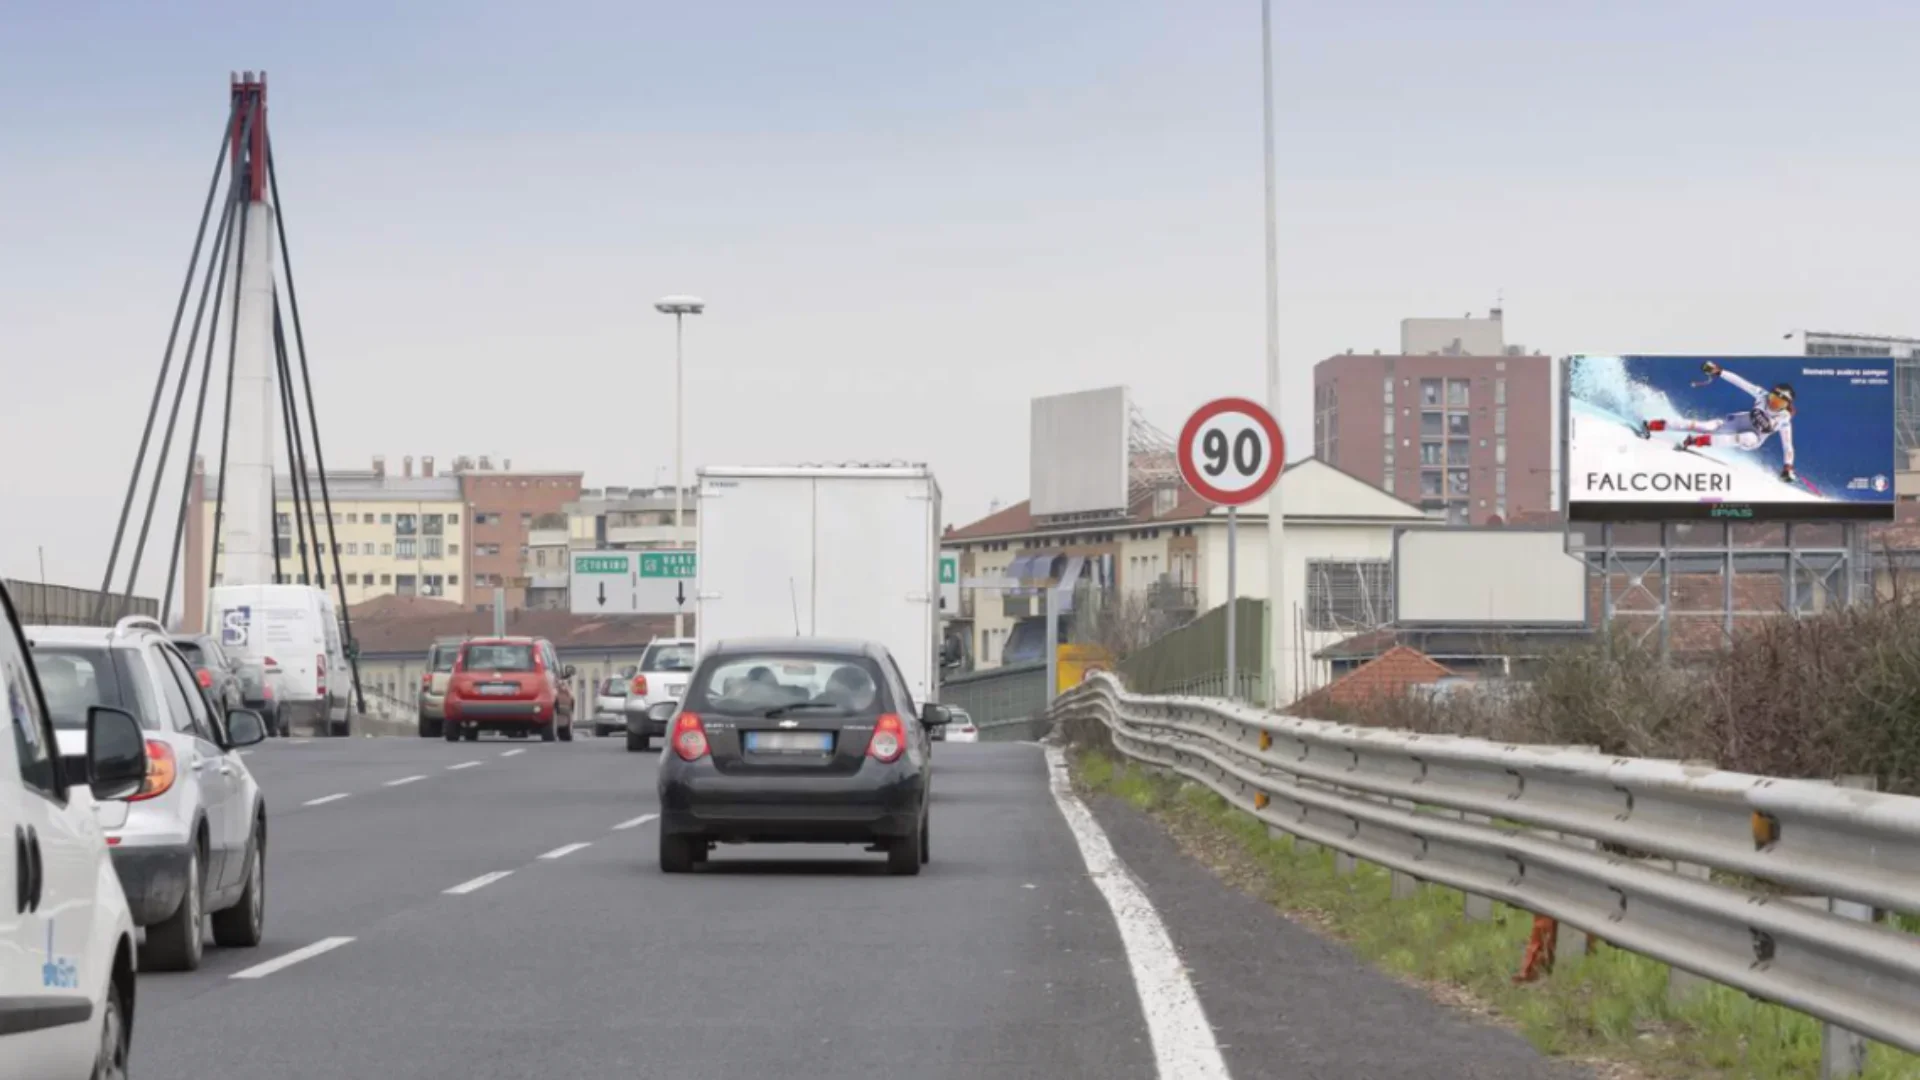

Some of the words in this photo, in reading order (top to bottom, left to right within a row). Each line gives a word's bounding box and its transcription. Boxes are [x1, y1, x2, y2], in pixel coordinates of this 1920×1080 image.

[1203, 428, 1262, 476] 90
[1586, 472, 1731, 491] FALCONERI
[590, 559, 627, 570] TORINO
